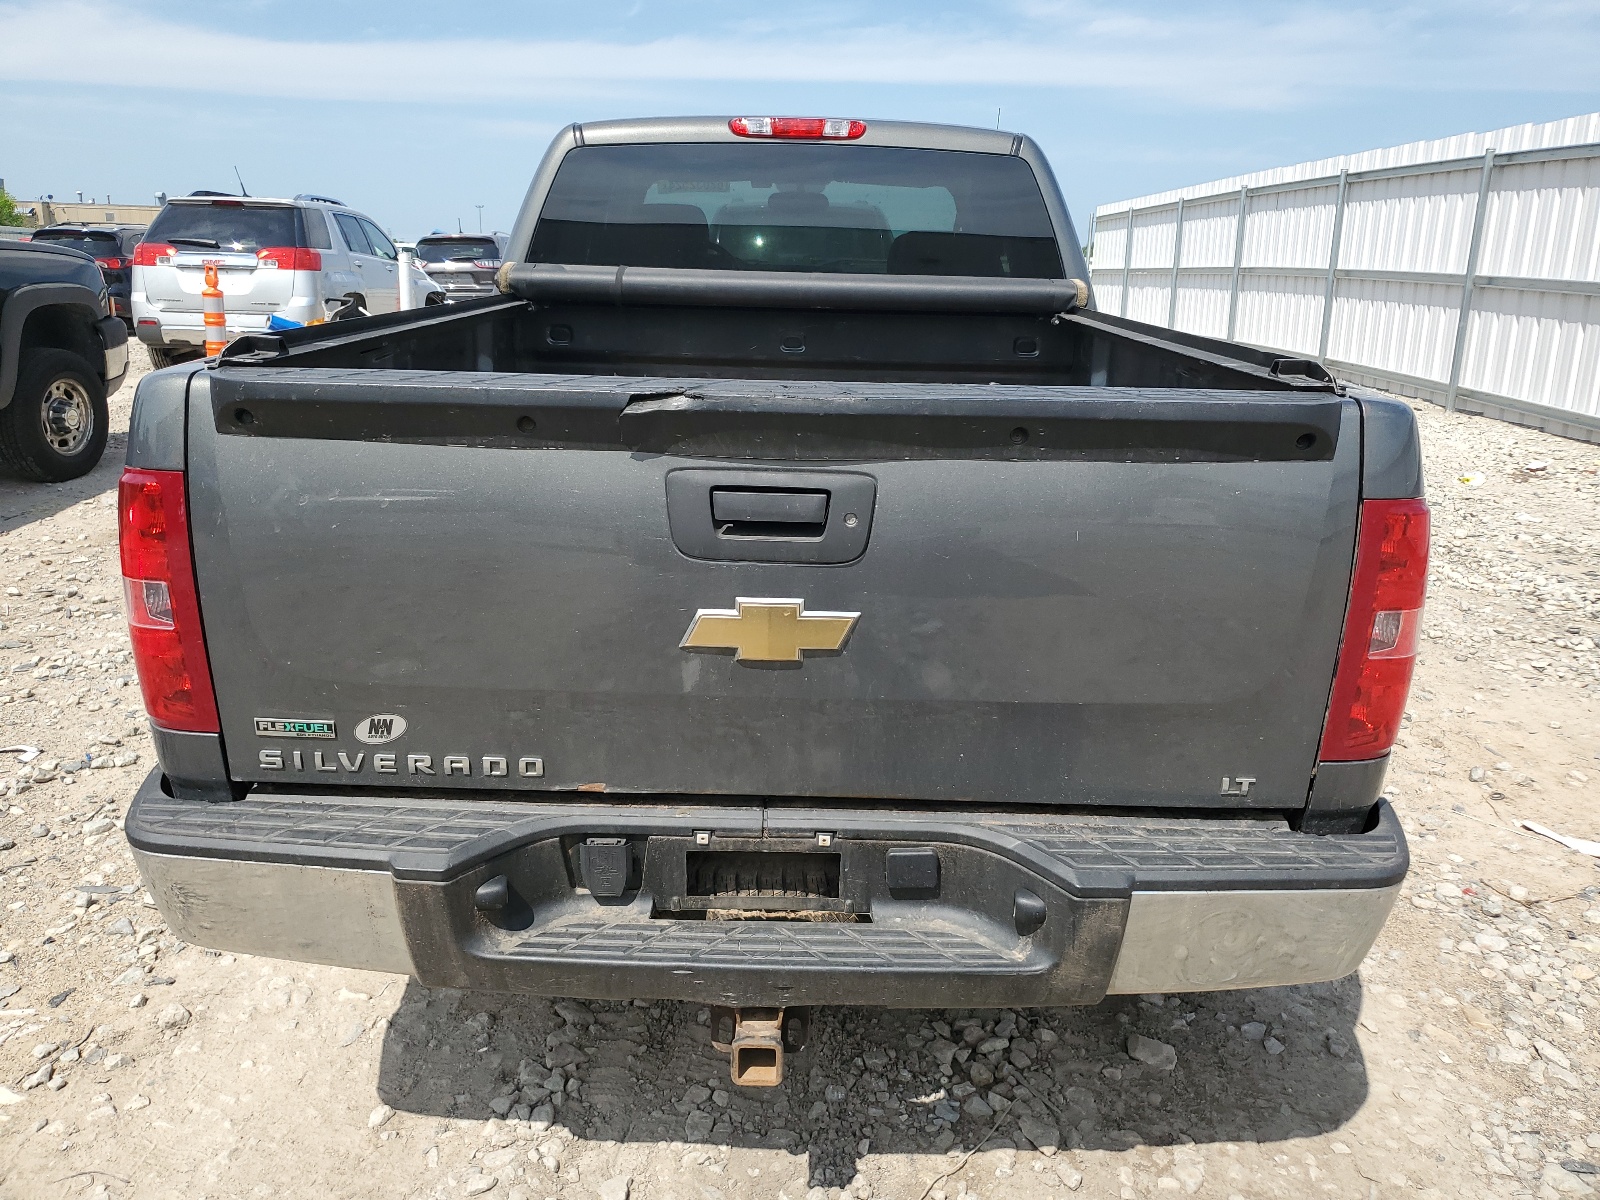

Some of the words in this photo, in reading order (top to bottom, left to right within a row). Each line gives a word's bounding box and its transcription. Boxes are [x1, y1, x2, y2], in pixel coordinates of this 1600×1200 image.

[258, 721, 332, 733] FLEXFUEL
[258, 750, 544, 777] SILVERADO
[1221, 777, 1257, 796] LT
